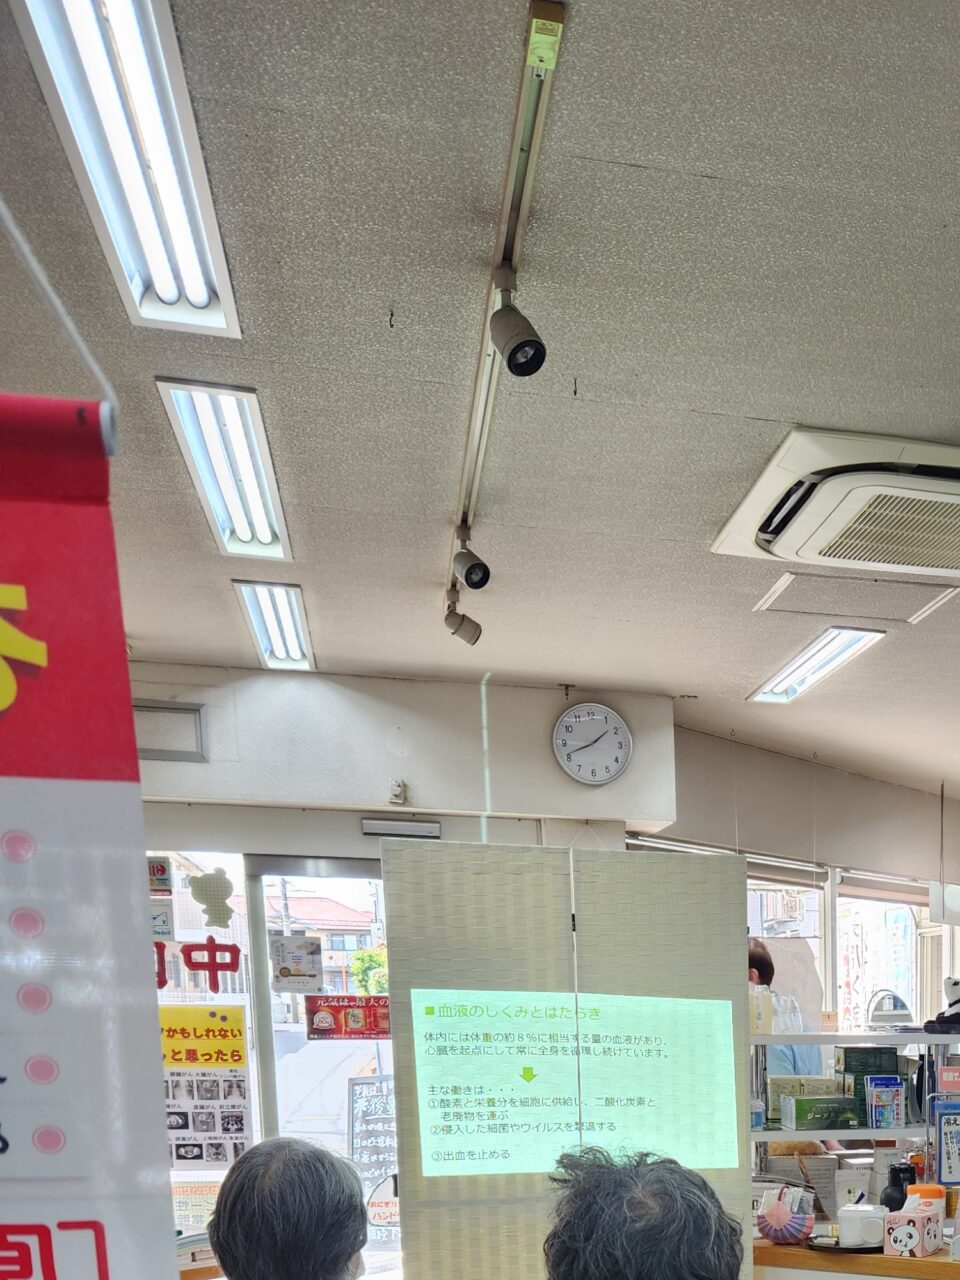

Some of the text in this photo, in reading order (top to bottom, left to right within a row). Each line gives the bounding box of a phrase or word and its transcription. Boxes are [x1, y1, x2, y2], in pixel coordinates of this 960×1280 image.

[574, 715, 581, 723] 11
[586, 712, 595, 720] 12
[604, 716, 608, 724] 1
[565, 725, 573, 733] 10
[613, 727, 619, 735] 2
[561, 739, 567, 747] 9
[617, 741, 623, 749] 3
[566, 754, 572, 762] 8
[613, 756, 619, 764] 4
[577, 765, 582, 773] 7
[591, 769, 597, 777] 6
[605, 766, 610, 774] 5
[438, 1003, 601, 1020] 血液のしくみとはたらき
[165, 1027, 242, 1039] かもしれない
[171, 1049, 243, 1063] と思ったら
[441, 1111, 509, 1122] 老廃物を運ぶ
[431, 1149, 510, 1162] ③出血を止める
